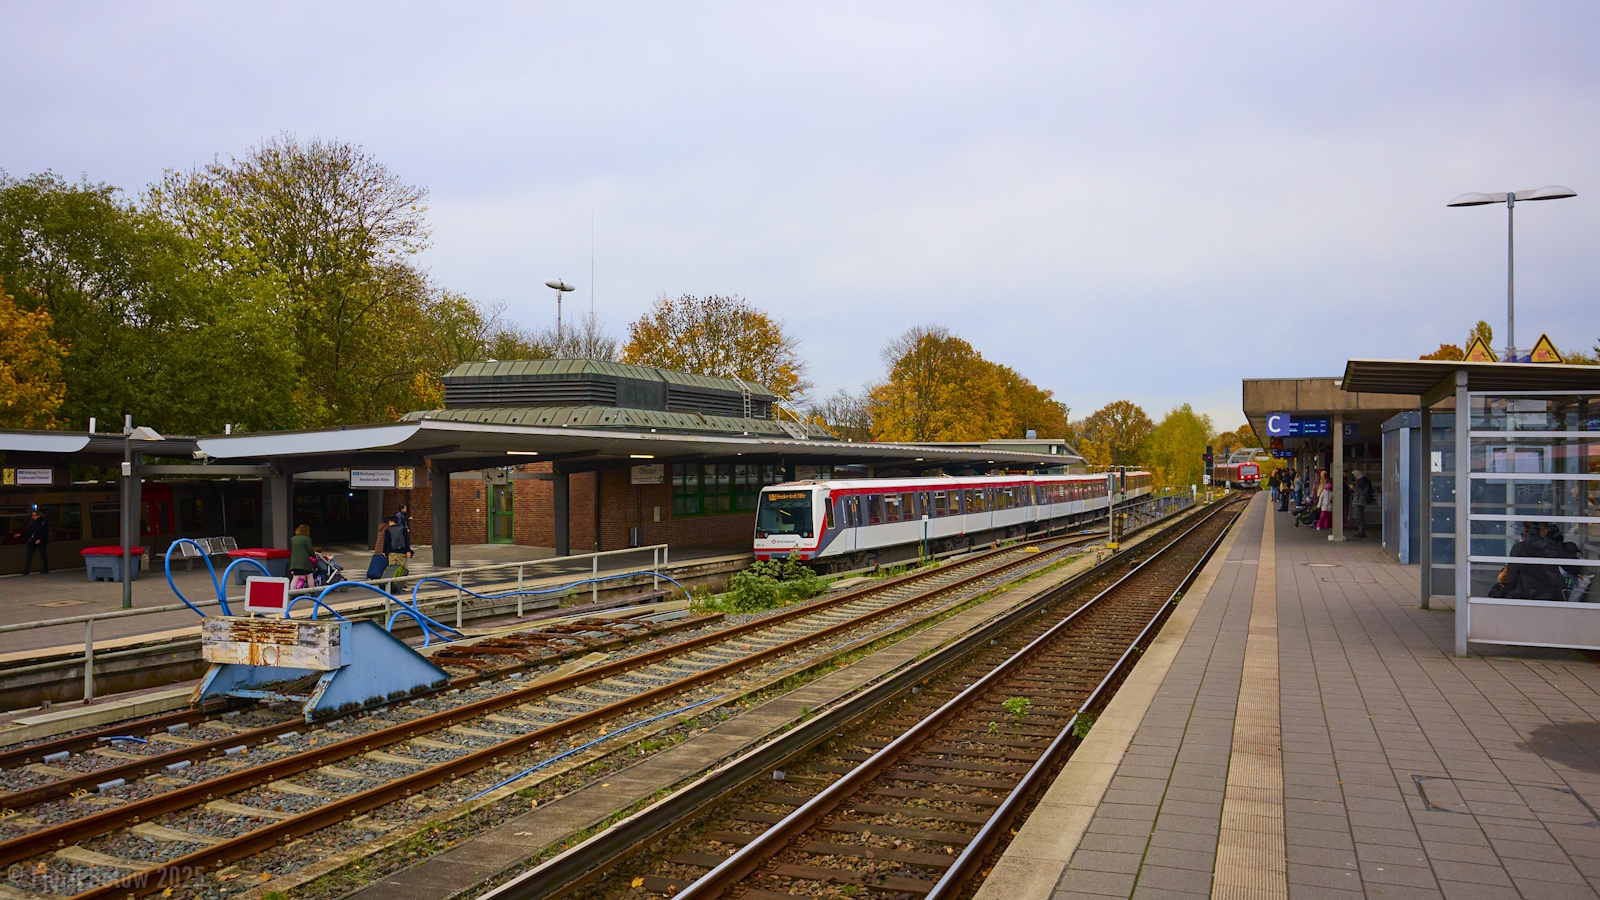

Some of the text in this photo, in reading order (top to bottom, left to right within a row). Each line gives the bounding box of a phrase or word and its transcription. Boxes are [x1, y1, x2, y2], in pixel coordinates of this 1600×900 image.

[1267, 415, 1282, 433] C
[1344, 425, 1352, 435] 5
[638, 467, 657, 475] Ohlsdorf
